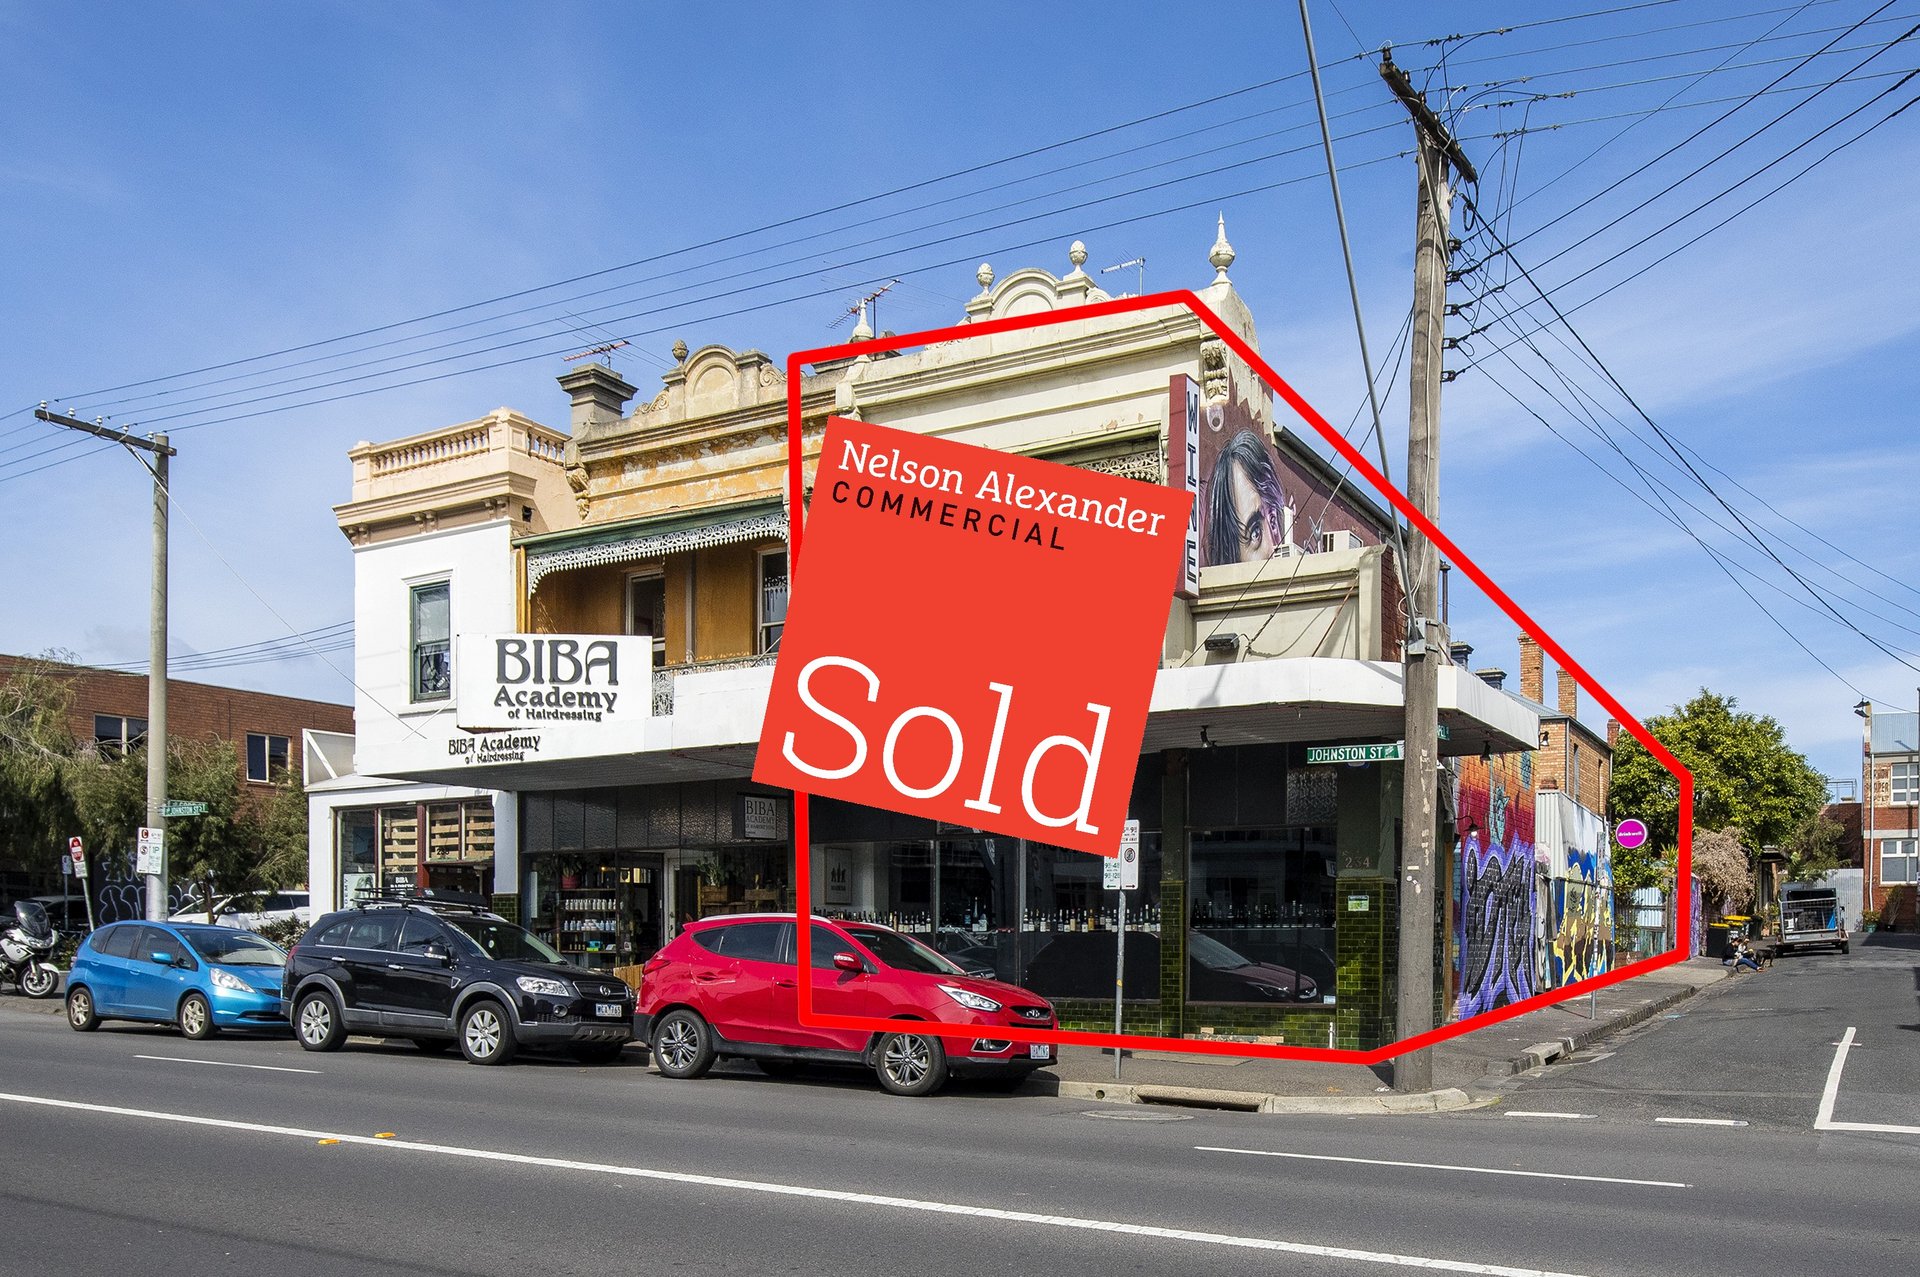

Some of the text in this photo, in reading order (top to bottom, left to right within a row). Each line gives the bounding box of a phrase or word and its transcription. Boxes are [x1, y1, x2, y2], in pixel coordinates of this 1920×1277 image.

[496, 639, 618, 686] BIBA
[494, 685, 617, 714] Academy
[508, 709, 602, 722] of Hairdressing
[448, 734, 541, 755] BIBA Academy
[477, 751, 525, 763] Hairdressing
[1310, 746, 1383, 761] JOHNSTON ST
[746, 800, 775, 816] BIBA
